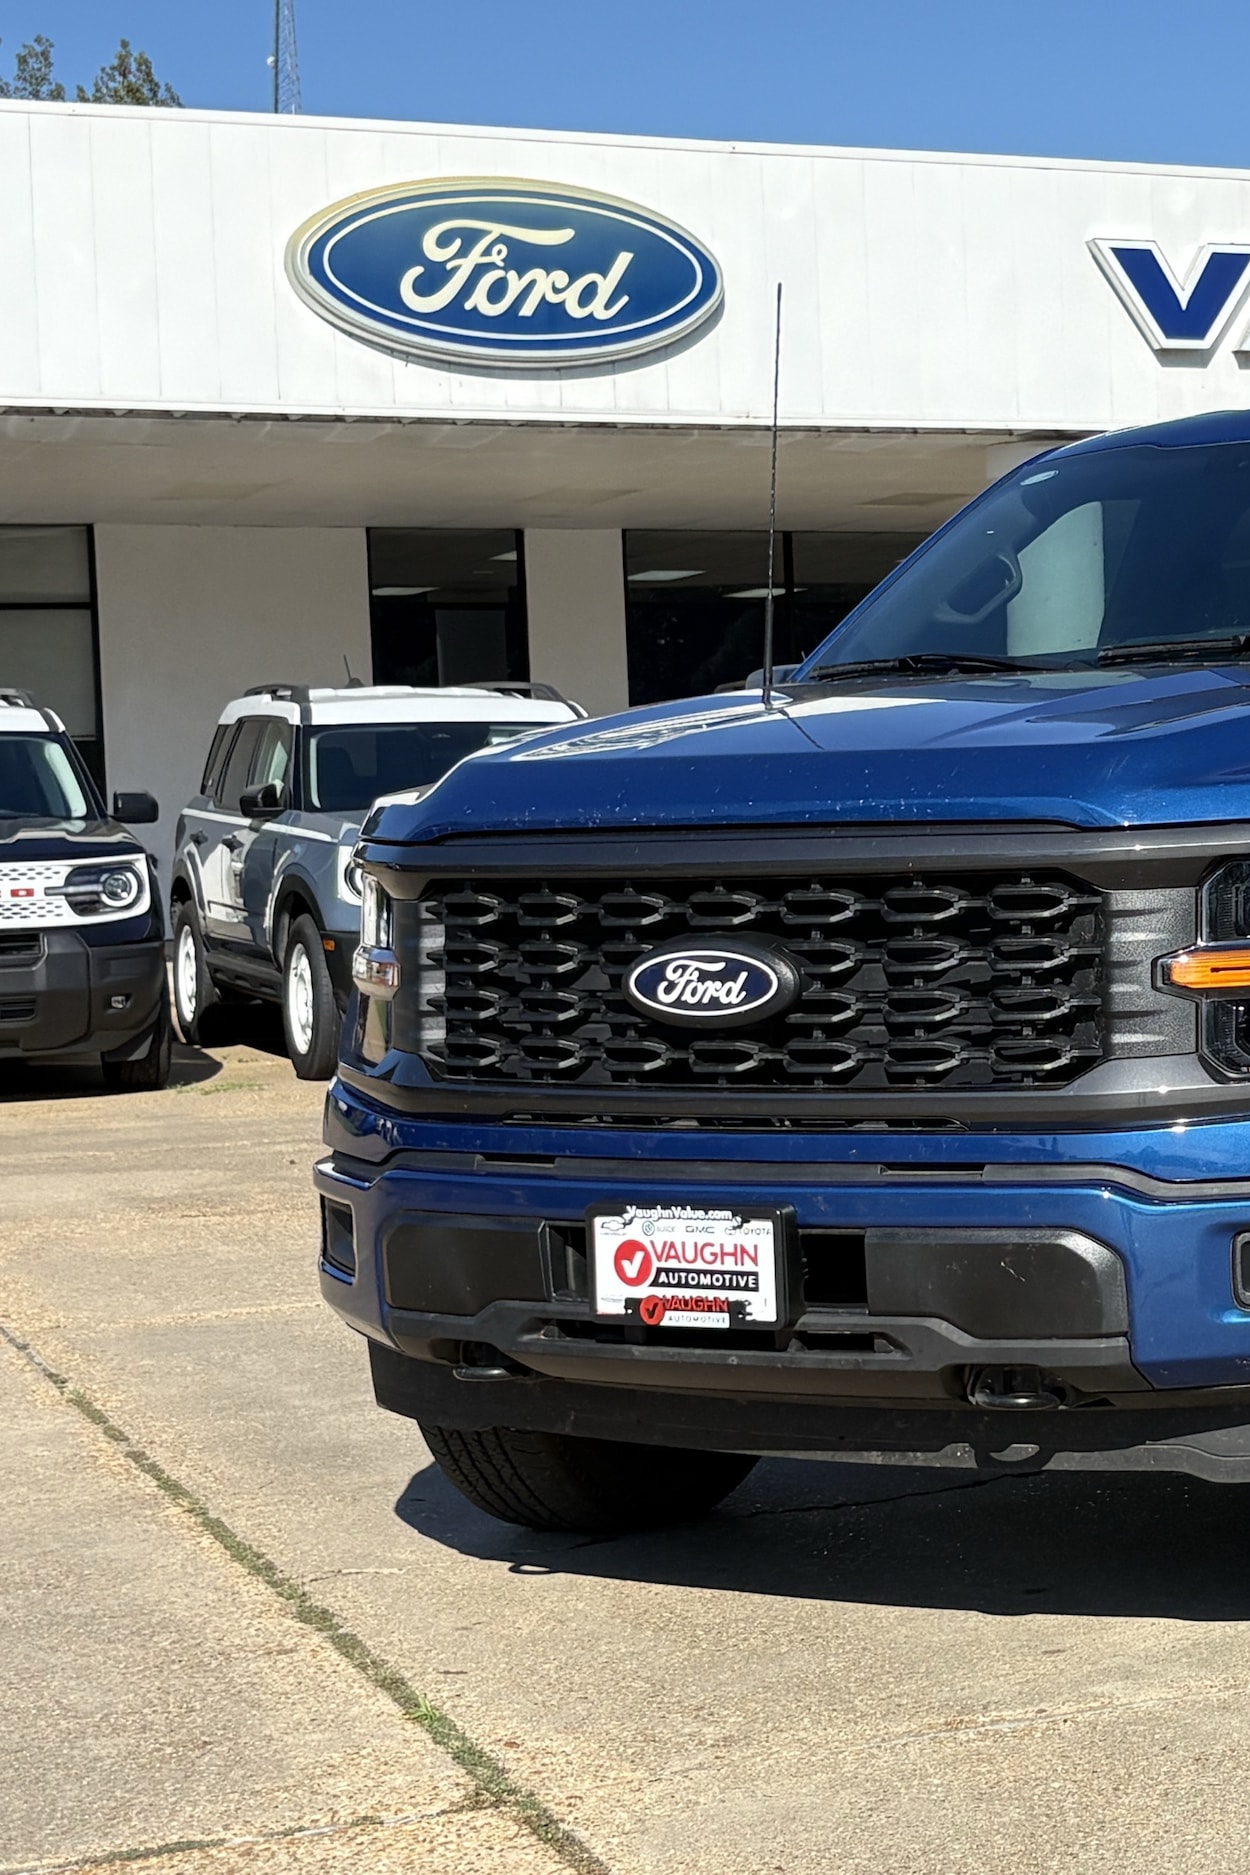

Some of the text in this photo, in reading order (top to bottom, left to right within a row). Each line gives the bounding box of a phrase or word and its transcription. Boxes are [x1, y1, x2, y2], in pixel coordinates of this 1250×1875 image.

[400, 218, 635, 320] Ford
[657, 959, 748, 1005] Ford
[625, 1204, 733, 1222] VaughnValue.com
[685, 1225, 715, 1234] GMC
[649, 1239, 759, 1268] VAUGHN
[658, 1271, 757, 1288] AUTOMOTIVE
[662, 1295, 729, 1312] VAUGHN
[668, 1315, 726, 1324] AUTOMOTIVE
